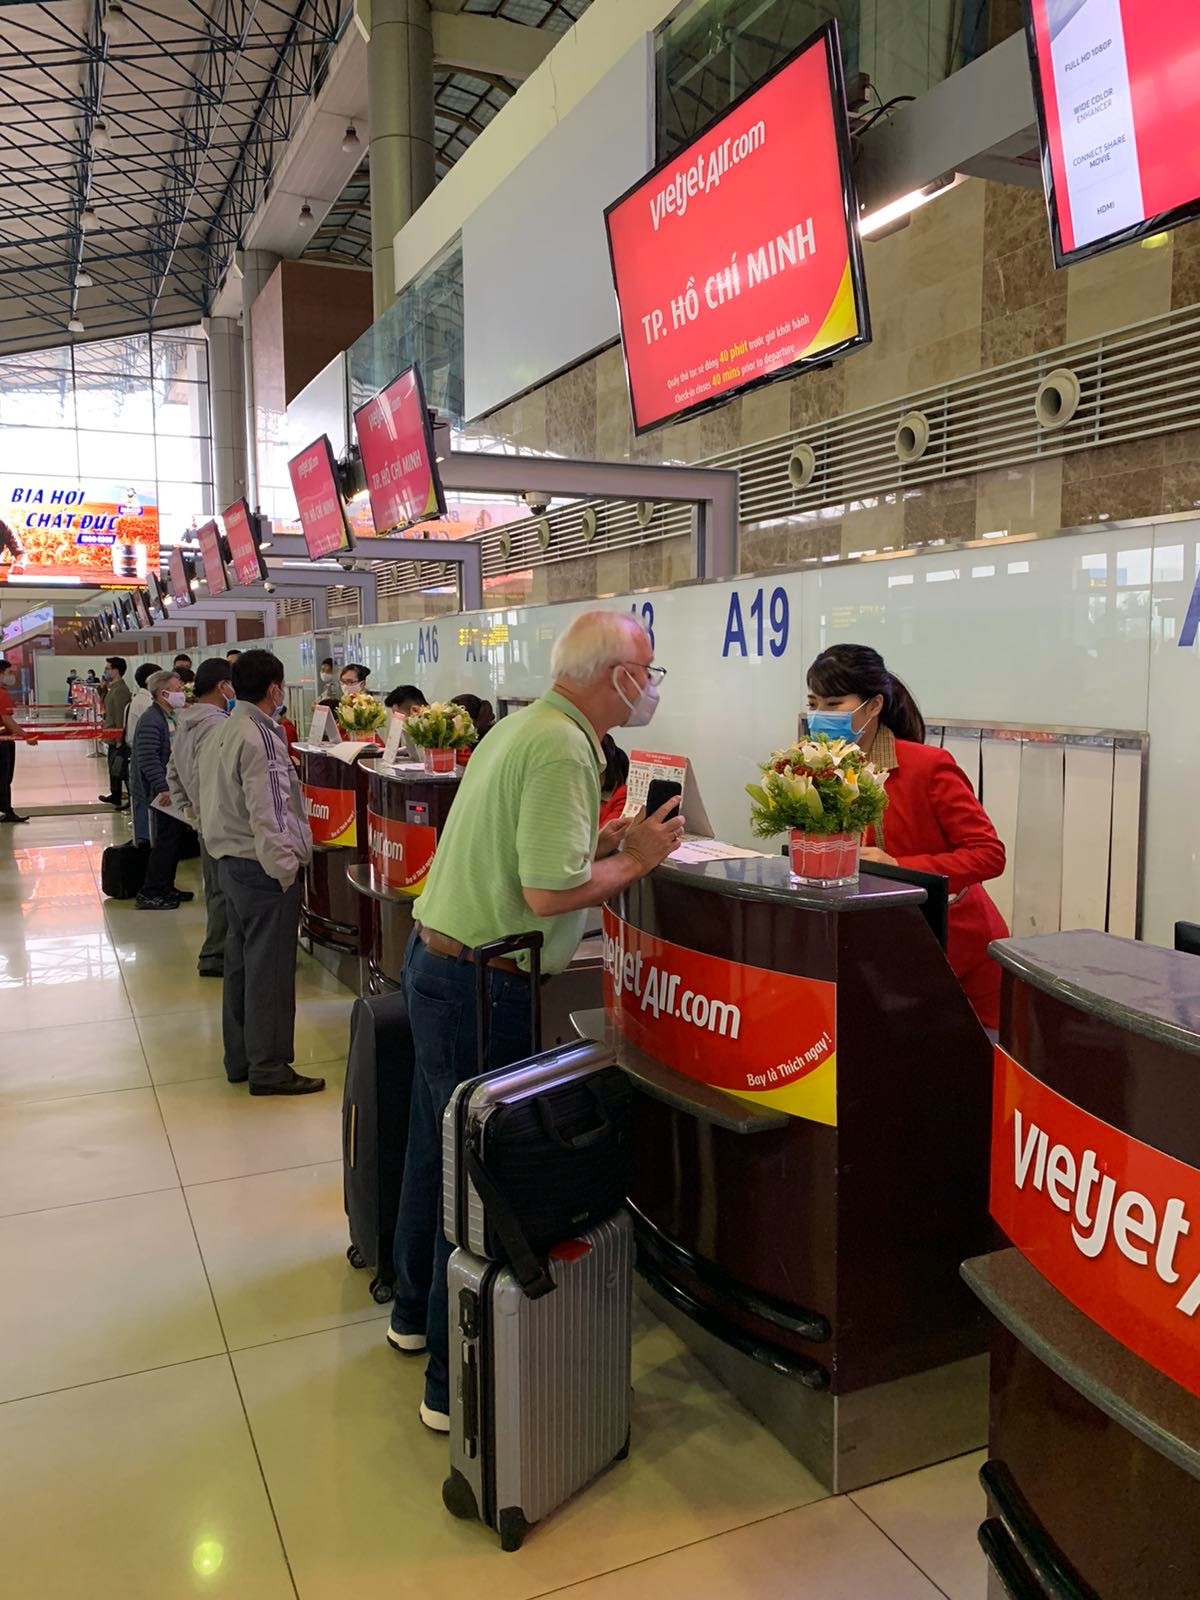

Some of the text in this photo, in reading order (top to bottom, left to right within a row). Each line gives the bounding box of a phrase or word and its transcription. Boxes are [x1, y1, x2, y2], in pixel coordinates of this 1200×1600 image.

[1064, 39, 1113, 73] FULL HD 1080P
[1073, 87, 1114, 115] WIDE COLOR
[1076, 101, 1113, 125] ENHANCER
[1072, 134, 1126, 167] CONNECT SHARE
[1089, 153, 1111, 169] MOVIE
[1097, 200, 1115, 216] HDMI
[641, 217, 817, 345] TP. HỒ CHÍ MINH
[719, 350, 729, 363] 40
[730, 340, 749, 359] phút
[674, 343, 796, 404] Check-in closes 40 mins prior to departure
[11, 488, 44, 504] BIA
[722, 587, 789, 657] A19
[417, 625, 439, 663] A16
[746, 1072, 766, 1087] Bay
[767, 1067, 778, 1082] là
[777, 1054, 806, 1077] Thích
